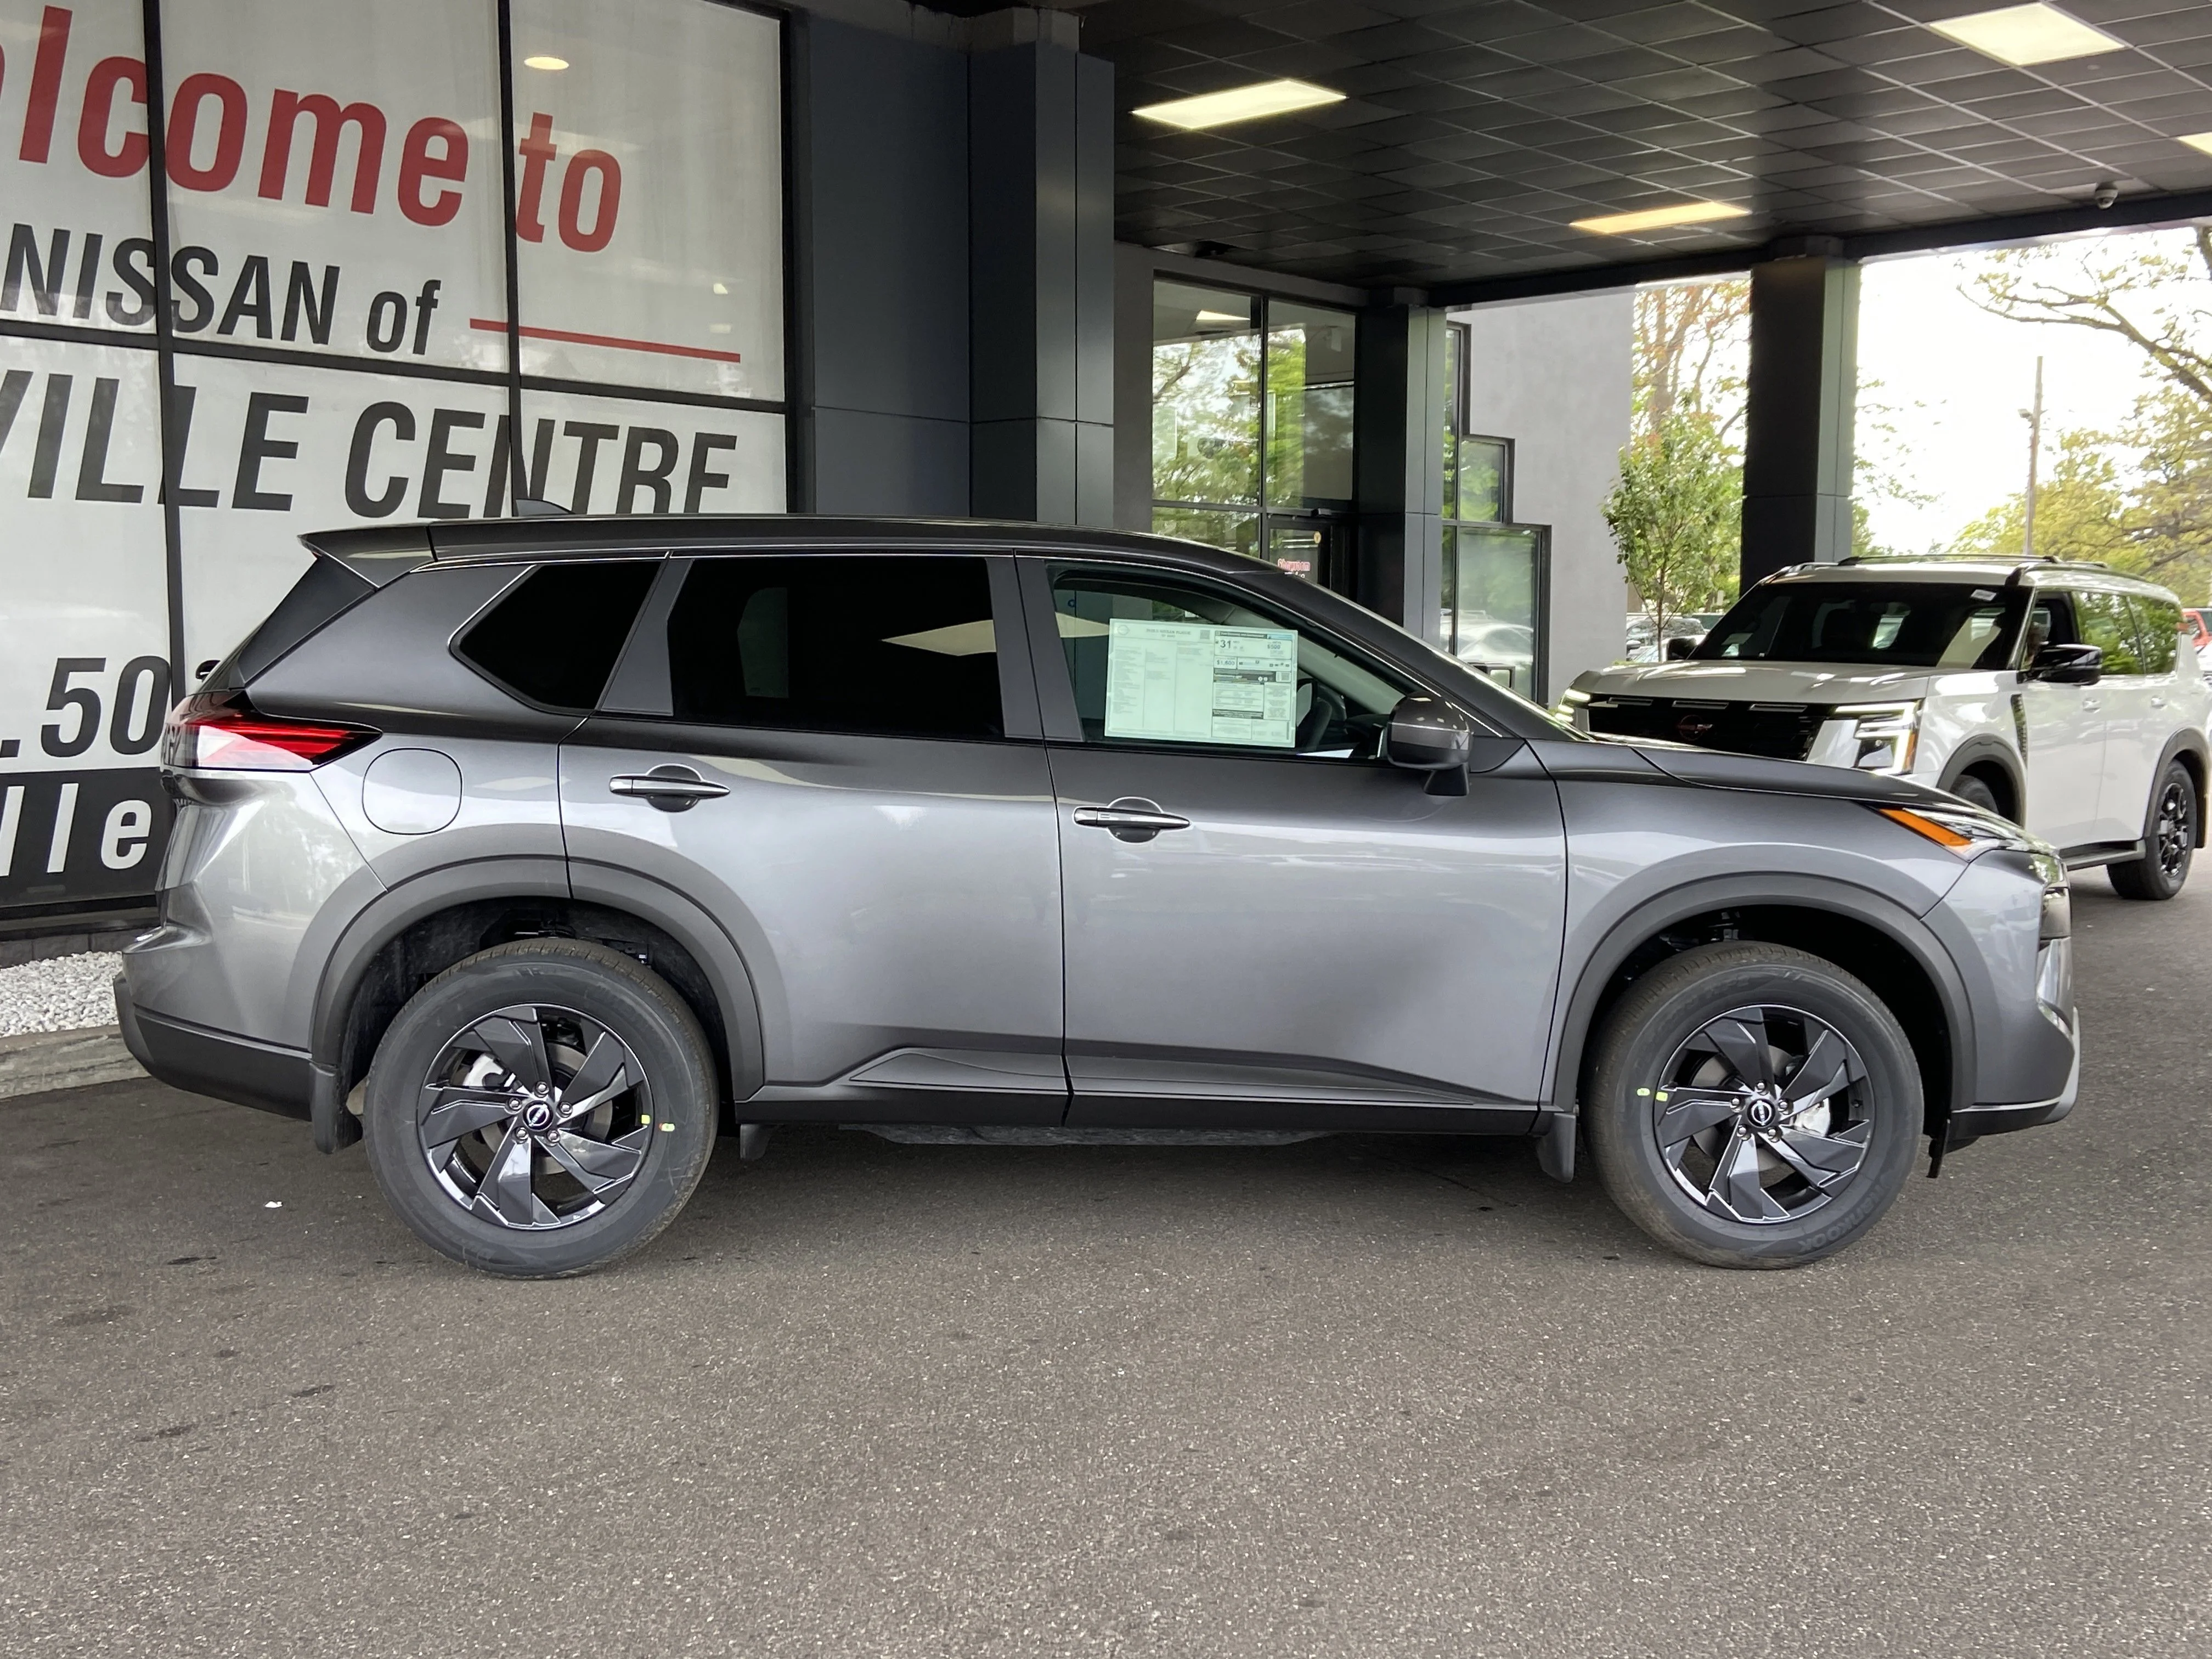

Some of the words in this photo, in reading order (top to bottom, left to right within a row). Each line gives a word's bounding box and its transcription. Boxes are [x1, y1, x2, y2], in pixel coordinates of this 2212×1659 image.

[0, 5, 469, 227] lcome
[516, 112, 622, 252] to
[0, 223, 340, 345] NISSAN
[366, 280, 441, 355] of
[345, 401, 737, 519] CENTRE
[1220, 640, 1232, 648] 31
